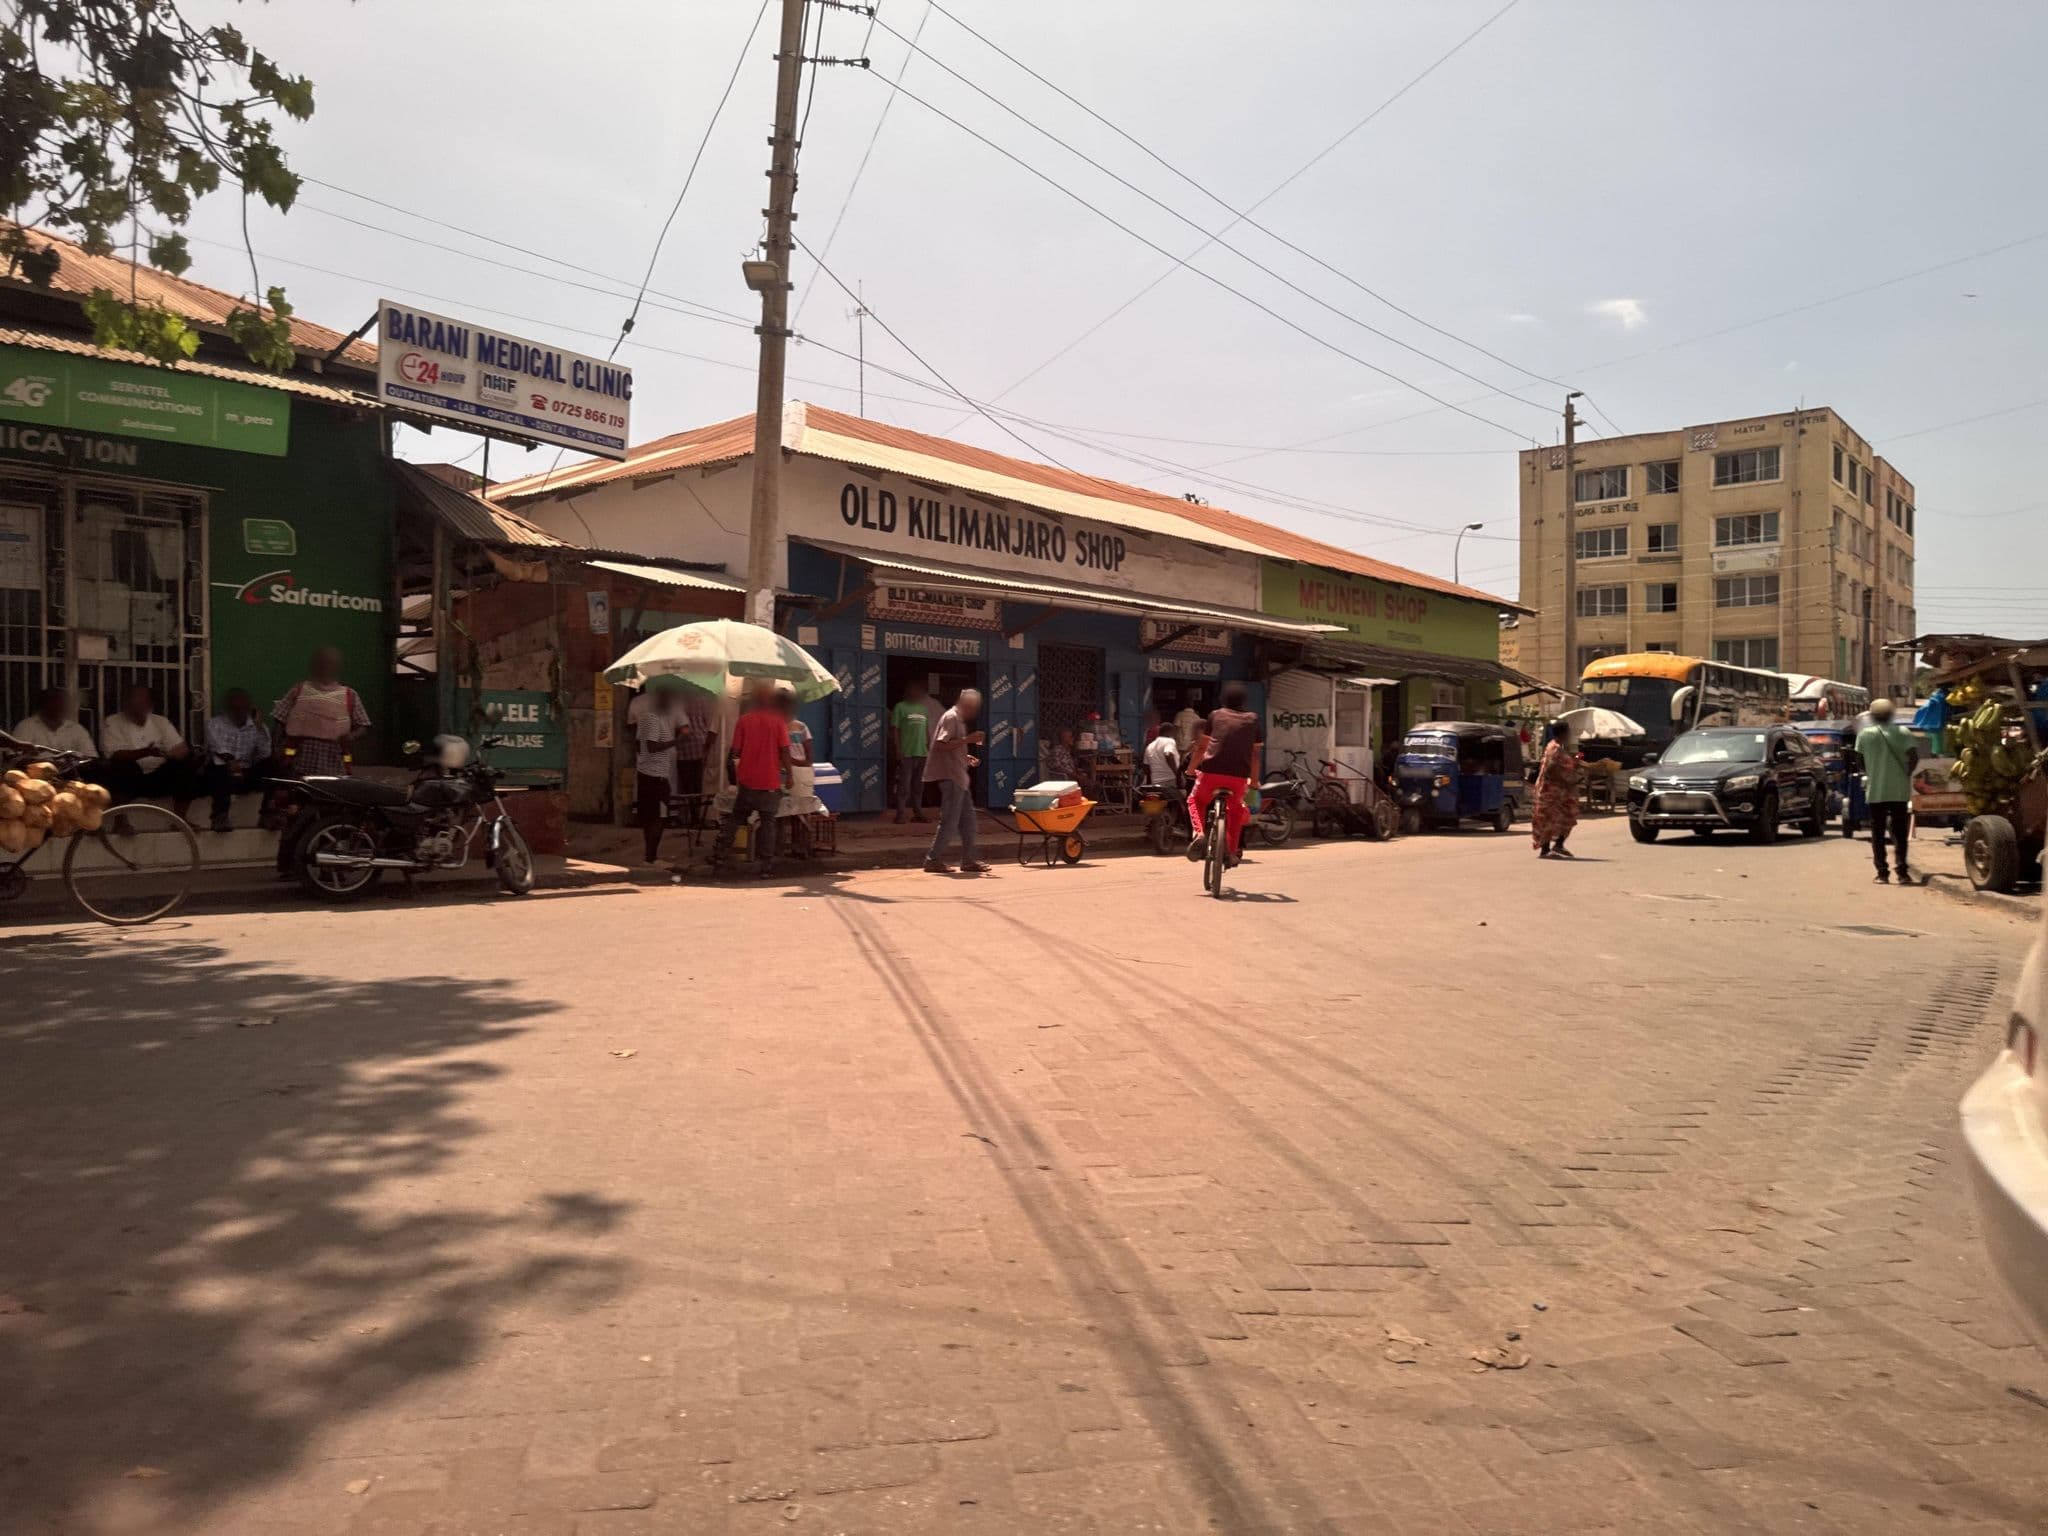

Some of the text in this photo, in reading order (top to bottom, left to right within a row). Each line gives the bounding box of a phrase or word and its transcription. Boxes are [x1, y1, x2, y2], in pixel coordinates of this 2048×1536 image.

[388, 308, 633, 401] BARANI MEDICAL CLINIC
[416, 360, 440, 385] 24
[4, 378, 52, 407] 4G
[78, 391, 203, 416] COMMUNICATIONS
[387, 386, 447, 407] OUTPATIENT
[552, 400, 625, 429] 0725 866 119
[841, 483, 1126, 572] OLD KILIMANJARO SHOP
[269, 584, 383, 613] Safaricom
[1300, 578, 1377, 619] MFUNENI
[1385, 592, 1427, 625] SHOP
[885, 631, 928, 651] BOTTEGA
[516, 735, 544, 748] BASE
